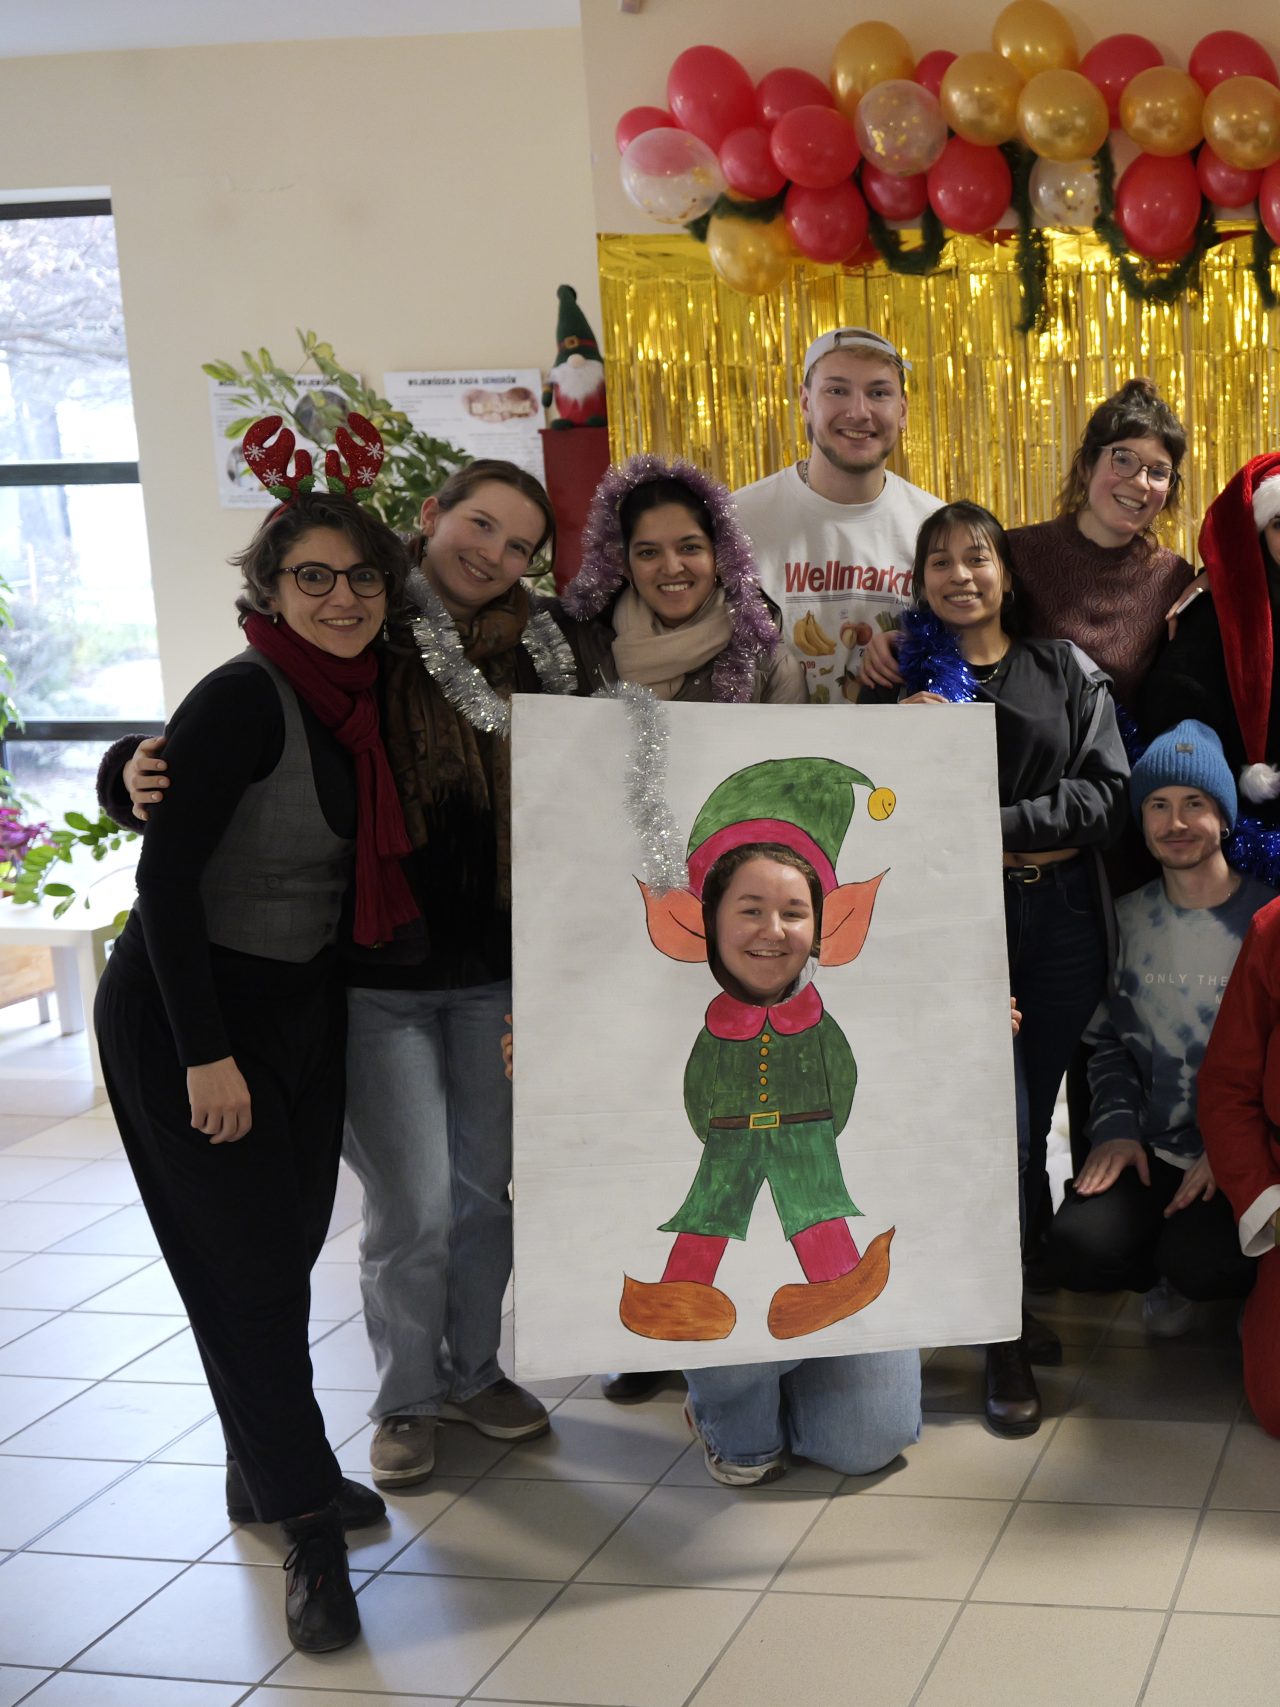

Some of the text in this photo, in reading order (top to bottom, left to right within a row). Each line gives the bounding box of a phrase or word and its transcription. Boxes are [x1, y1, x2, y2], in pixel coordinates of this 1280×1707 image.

[785, 560, 913, 597] Wellmarkt
[1144, 972, 1228, 987] ONLY THE
